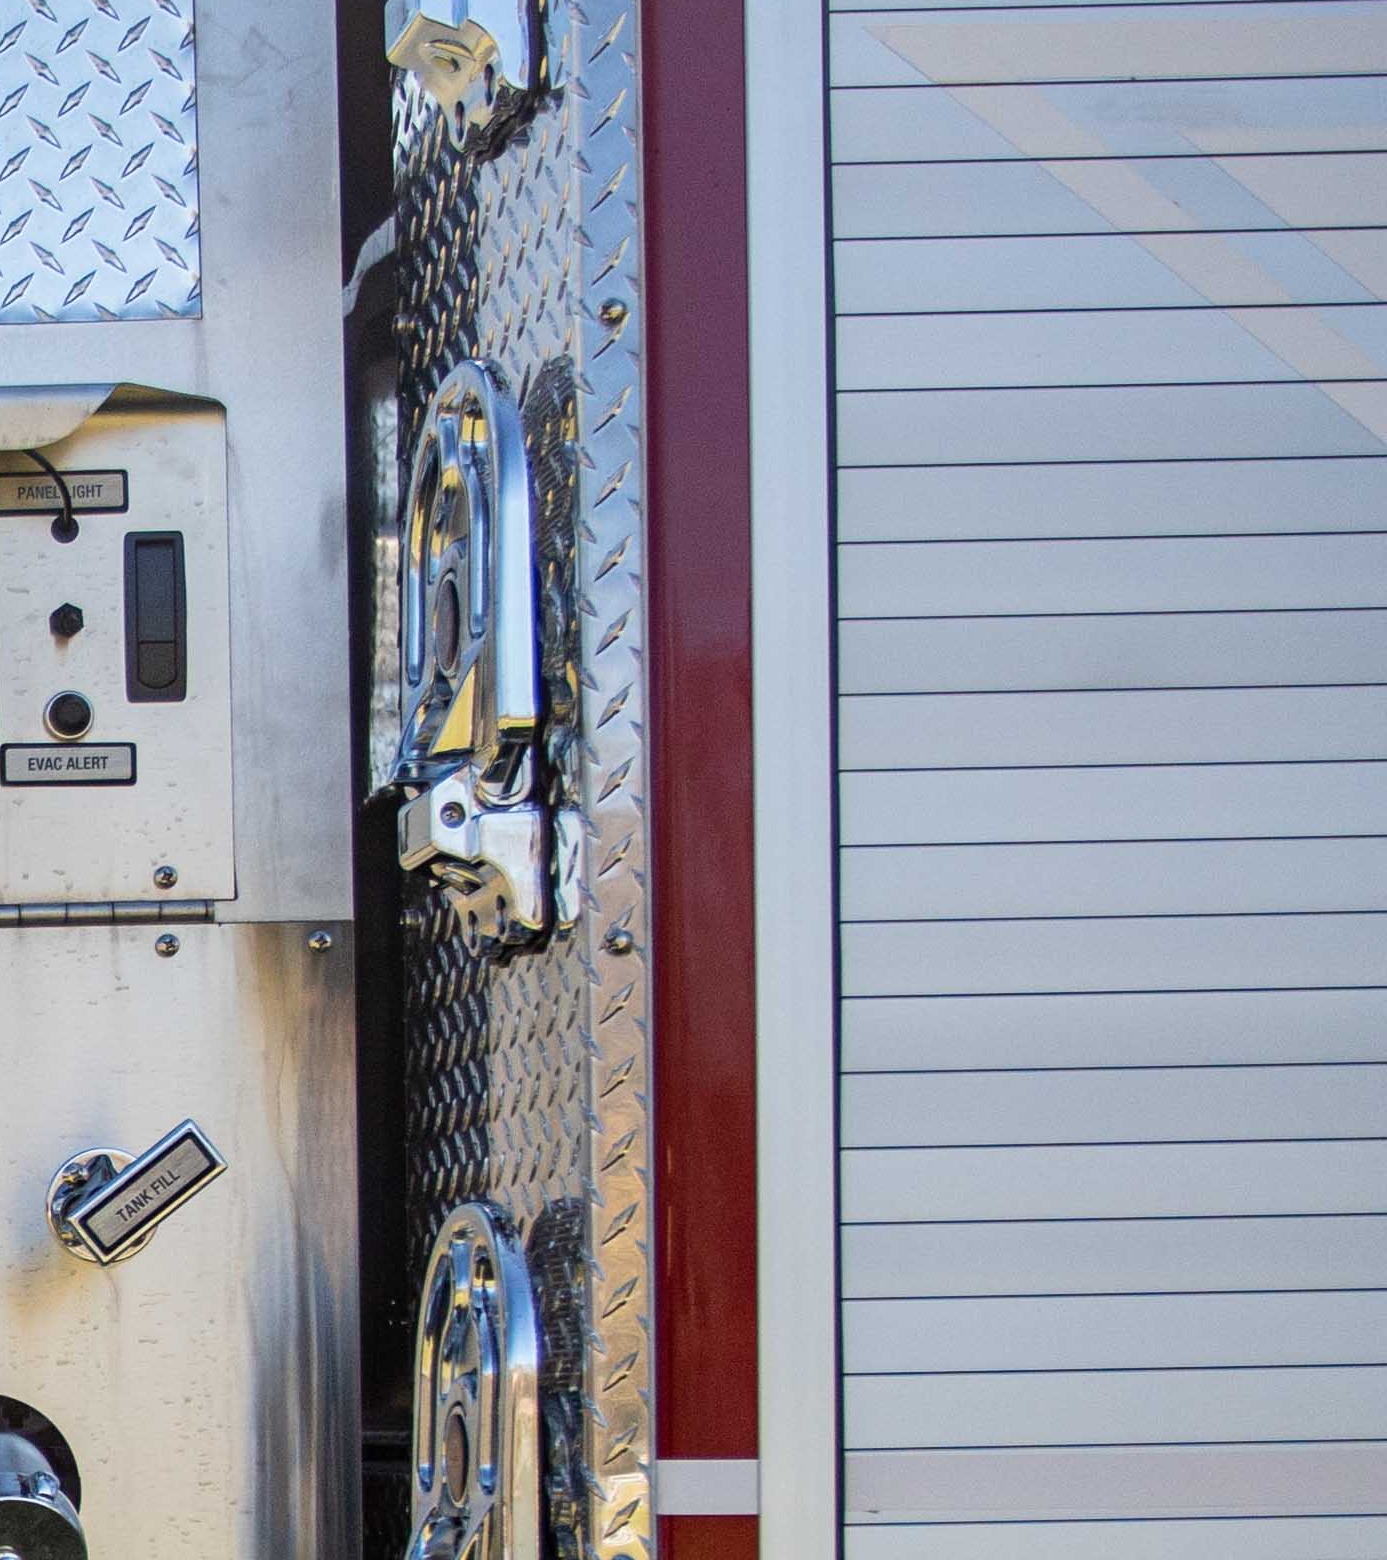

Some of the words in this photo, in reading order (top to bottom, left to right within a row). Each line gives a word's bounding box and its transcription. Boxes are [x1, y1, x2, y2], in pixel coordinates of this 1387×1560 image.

[17, 486, 60, 500] PANEL
[69, 484, 103, 499] IGHT
[27, 757, 62, 771] EVAC
[66, 756, 109, 771] ALERT
[115, 1188, 154, 1222] TANK
[151, 1169, 181, 1195] FILL
